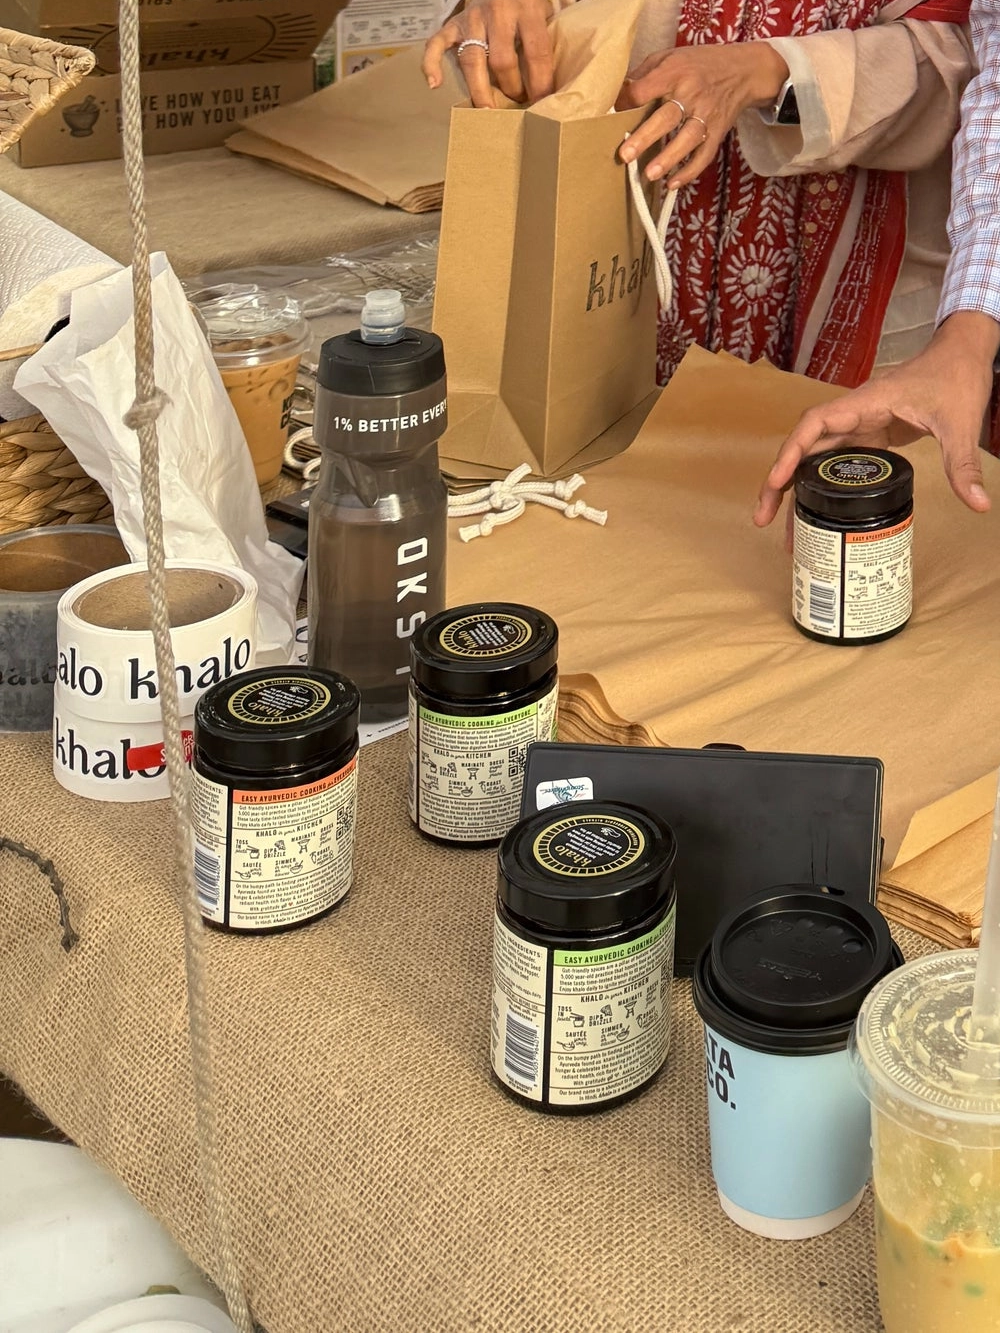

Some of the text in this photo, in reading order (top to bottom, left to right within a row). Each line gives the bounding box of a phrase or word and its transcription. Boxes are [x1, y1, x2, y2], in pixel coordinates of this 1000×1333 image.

[167, 93, 206, 109] HOW
[212, 89, 244, 104] YOU
[253, 85, 281, 102] EAT
[156, 114, 194, 129] HOW
[202, 108, 236, 125] YOU
[334, 416, 353, 432] 1%
[358, 414, 418, 433] BETTER
[435, 717, 466, 727] AYURVEDIC
[504, 709, 531, 724] EVERYONE
[434, 749, 450, 758] KHALO
[260, 792, 297, 802] AYURVEDIC
[300, 783, 326, 797] COOKING
[256, 830, 277, 838] KHALO
[297, 819, 323, 832] KITCHEN
[554, 845, 592, 868] khalo
[584, 950, 625, 963] AYURVEDIC
[627, 937, 653, 954] COOKING
[580, 994, 603, 1003] KHALO
[624, 977, 649, 993] KITCHEN
[589, 1018, 612, 1027] DRIZZLE
[601, 1023, 623, 1033] SIMMER
